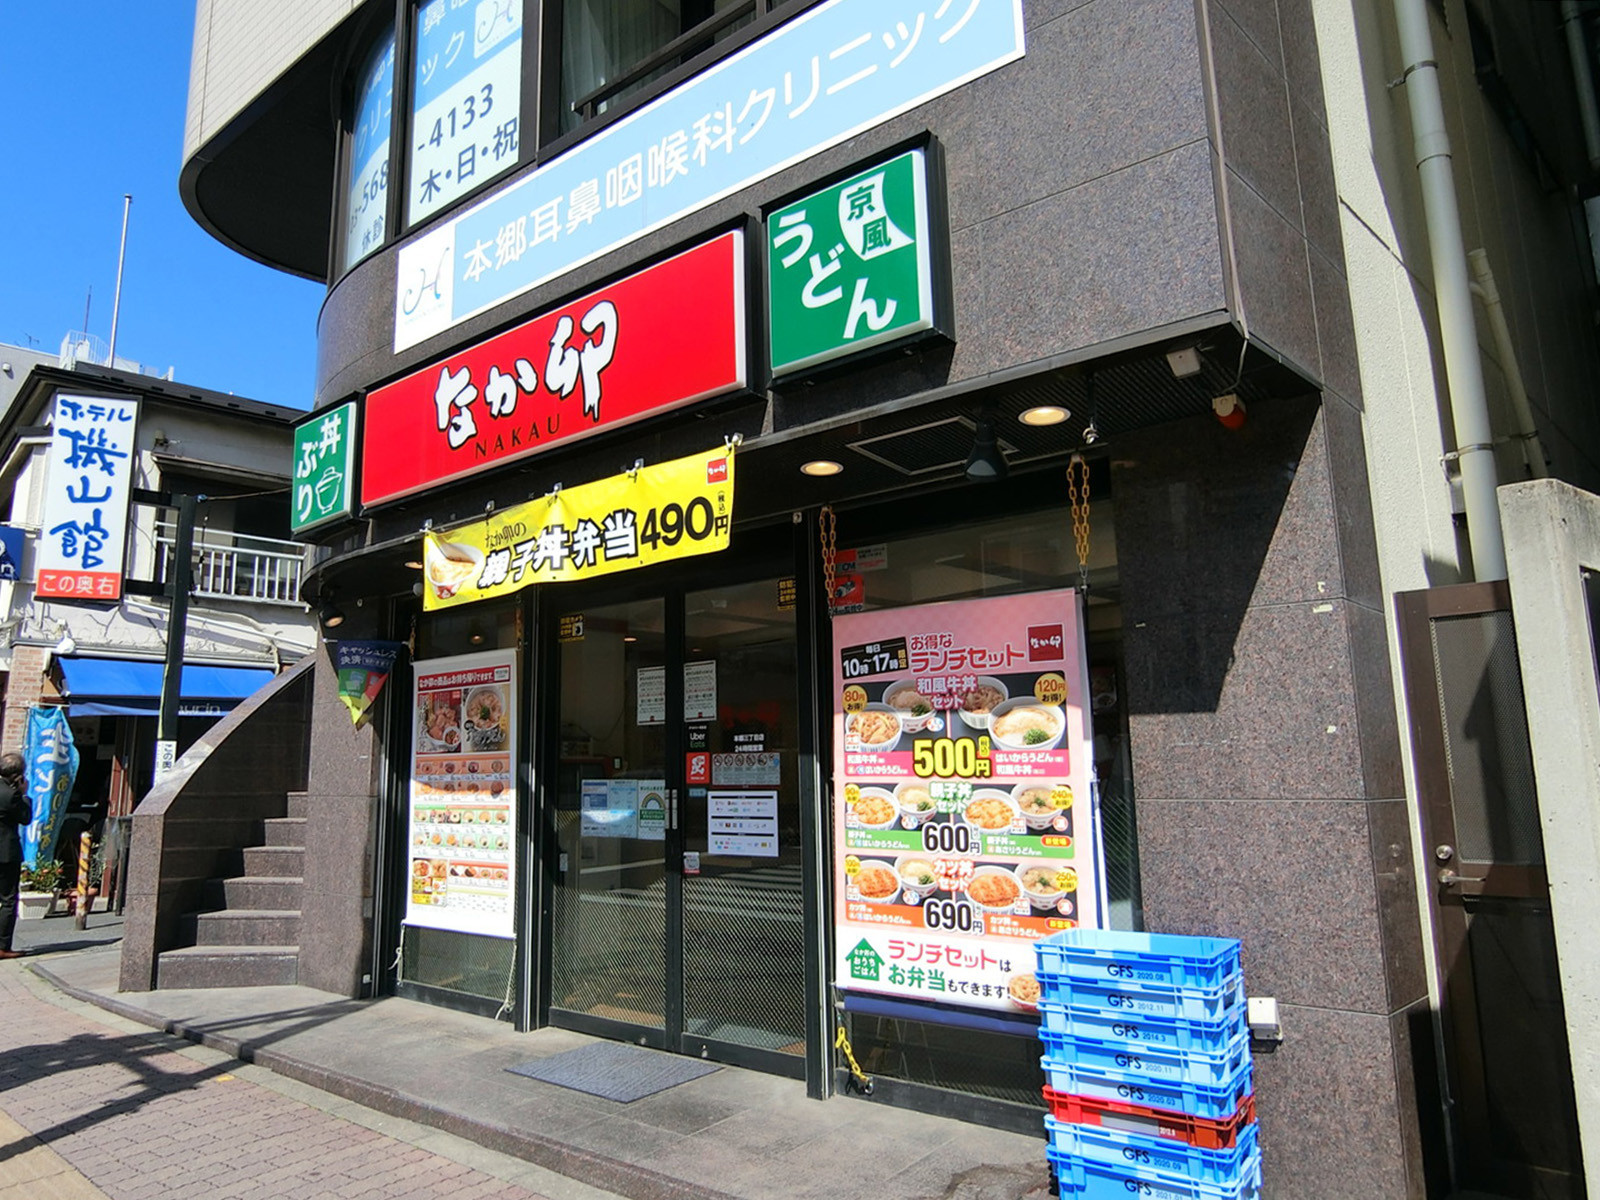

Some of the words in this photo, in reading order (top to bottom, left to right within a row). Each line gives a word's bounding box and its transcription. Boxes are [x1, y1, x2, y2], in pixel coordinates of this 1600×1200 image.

[417, 83, 494, 151] -4133
[462, 0, 982, 283] 本郷耳鼻咽喉科クリニック
[419, 116, 519, 205] 木・日・祝
[846, 183, 892, 255] 京風
[773, 209, 898, 339] うどん
[434, 299, 619, 449] なか卯
[60, 398, 133, 423] ホテル
[474, 413, 562, 459] NAKAU
[477, 506, 640, 590] 親子丼弁当
[640, 494, 729, 551] 490円
[41, 573, 117, 597] この奥右
[910, 634, 953, 651] お得な
[1030, 634, 1062, 649] なか卯
[910, 643, 1026, 674] ランチセット
[916, 675, 978, 697] 和風牛丼
[1037, 679, 1066, 693] 120円
[930, 694, 964, 709] セット
[689, 732, 706, 741] Uber
[913, 737, 991, 778] 500円
[923, 822, 982, 855] 600円
[933, 857, 974, 876] カツ丼
[926, 898, 984, 933] 690円
[853, 966, 877, 978] ごはん
[1107, 963, 1134, 978] GFS
[1107, 993, 1134, 1009] GFS
[1112, 1023, 1140, 1039] GFS
[1114, 1053, 1142, 1070] GFS
[1117, 1084, 1145, 1101] GFS
[1122, 1146, 1151, 1164] GFS
[1124, 1178, 1152, 1196] GFS
